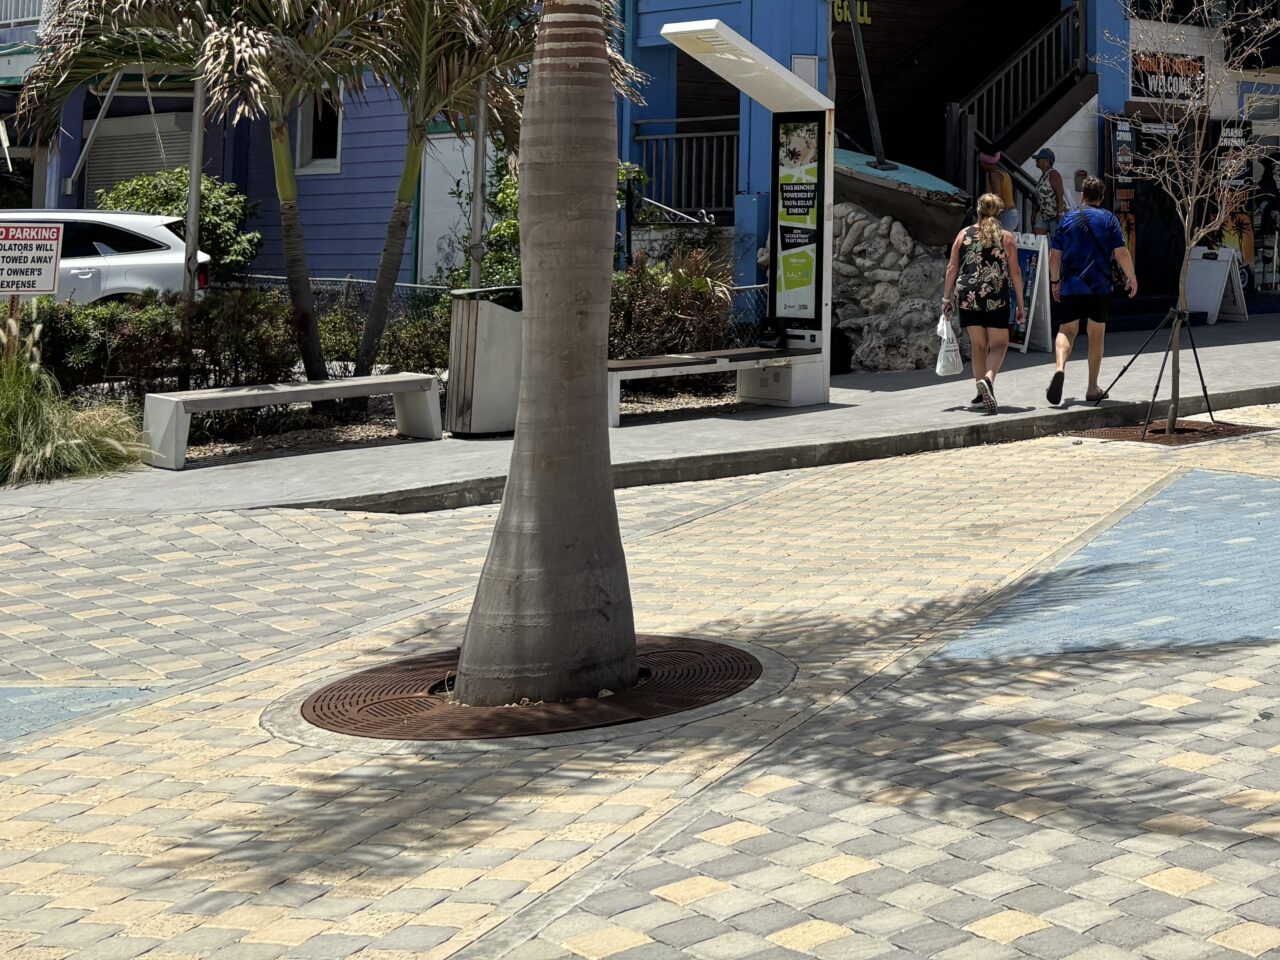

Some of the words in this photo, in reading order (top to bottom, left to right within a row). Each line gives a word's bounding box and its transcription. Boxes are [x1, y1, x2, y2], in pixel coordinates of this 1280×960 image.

[8, 227, 57, 240] PARKING
[35, 243, 54, 252] WILL
[1, 255, 28, 264] TOWED
[30, 255, 53, 264] AWAY
[6, 268, 42, 276] OWNER'S
[0, 280, 37, 289] EXPENSE
